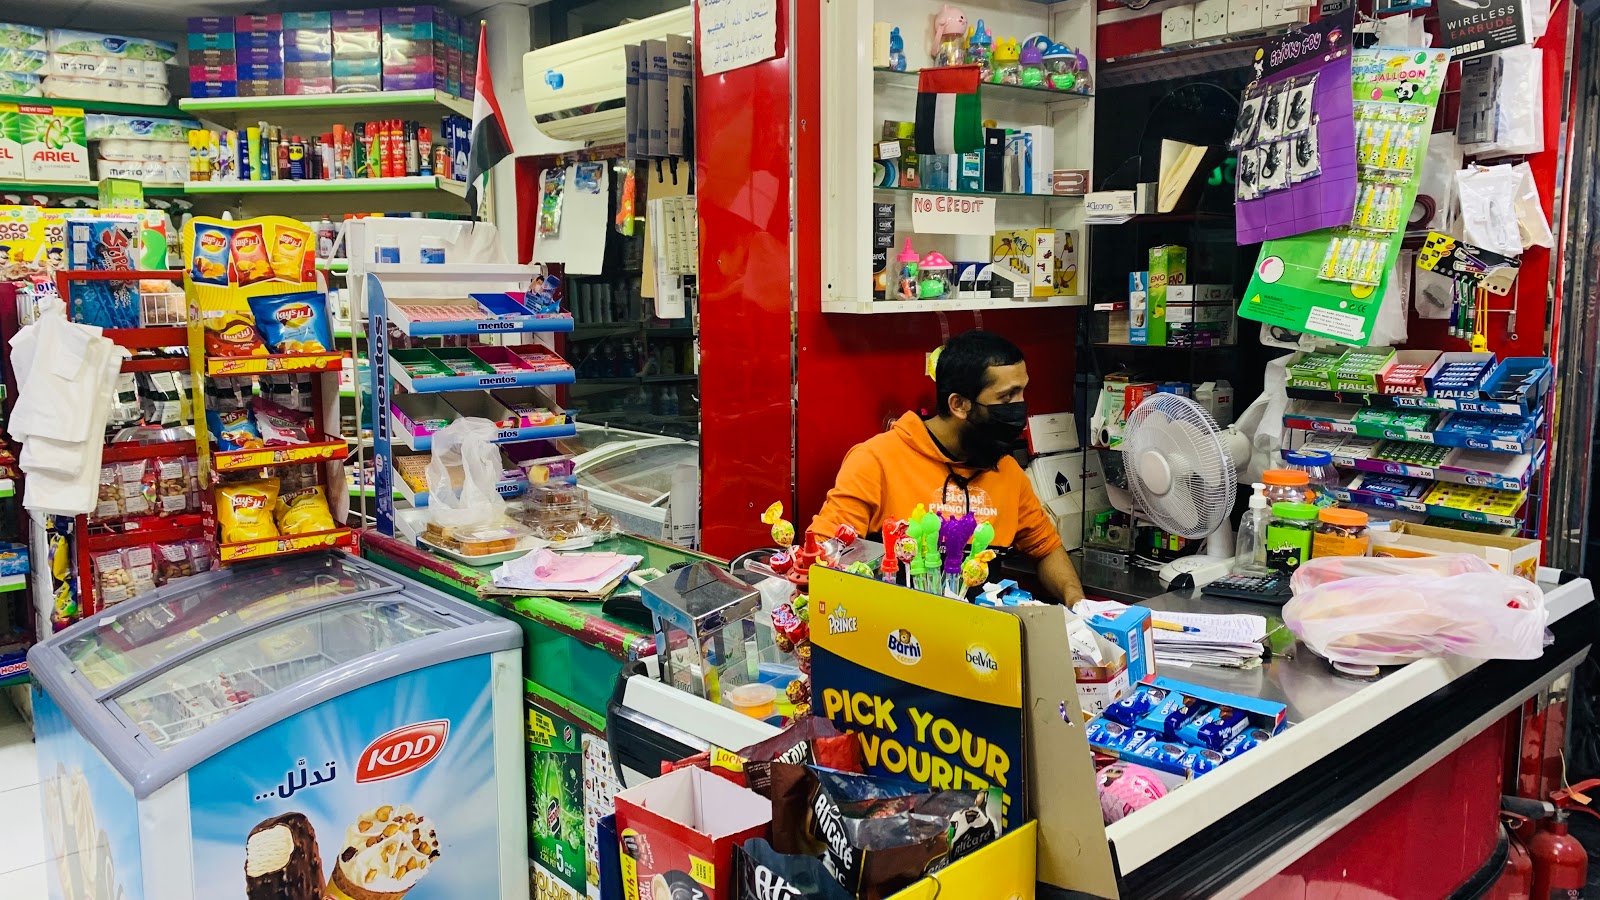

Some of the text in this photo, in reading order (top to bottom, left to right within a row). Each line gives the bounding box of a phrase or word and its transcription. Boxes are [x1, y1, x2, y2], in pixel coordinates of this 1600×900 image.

[1447, 5, 1515, 30] WIRELESS
[1451, 16, 1513, 40] EARBUDS
[1352, 63, 1385, 75] SPACE
[33, 151, 80, 163] ARIEL
[914, 196, 984, 214] NO CREDIT
[1150, 274, 1166, 283] ENO
[1168, 272, 1184, 286] ENO
[276, 307, 297, 321] Lay's
[477, 321, 515, 330] mentos
[374, 316, 388, 440] mentos
[479, 376, 517, 386] mentos
[1336, 372, 1359, 380] HALLS
[1292, 379, 1328, 389] HALLS
[1338, 382, 1373, 392] HALLS
[1384, 385, 1423, 395] HALLS
[1433, 389, 1475, 399] HALLS
[1461, 403, 1477, 411] XXL
[496, 429, 518, 439] ntos
[1469, 440, 1489, 449] Extra
[495, 483, 519, 493] ntos
[1367, 484, 1392, 492] HALLS
[232, 496, 253, 508] Lay's
[945, 492, 985, 505] GLOAL
[928, 503, 998, 517] PHENOENON
[828, 614, 858, 635] PRINCE
[888, 634, 922, 658] Barni
[965, 649, 999, 671] belVita
[1086, 724, 1102, 738] REO
[822, 687, 1011, 788] PICK YOUR
[367, 735, 437, 772] KDD
[555, 843, 565, 873] 5
